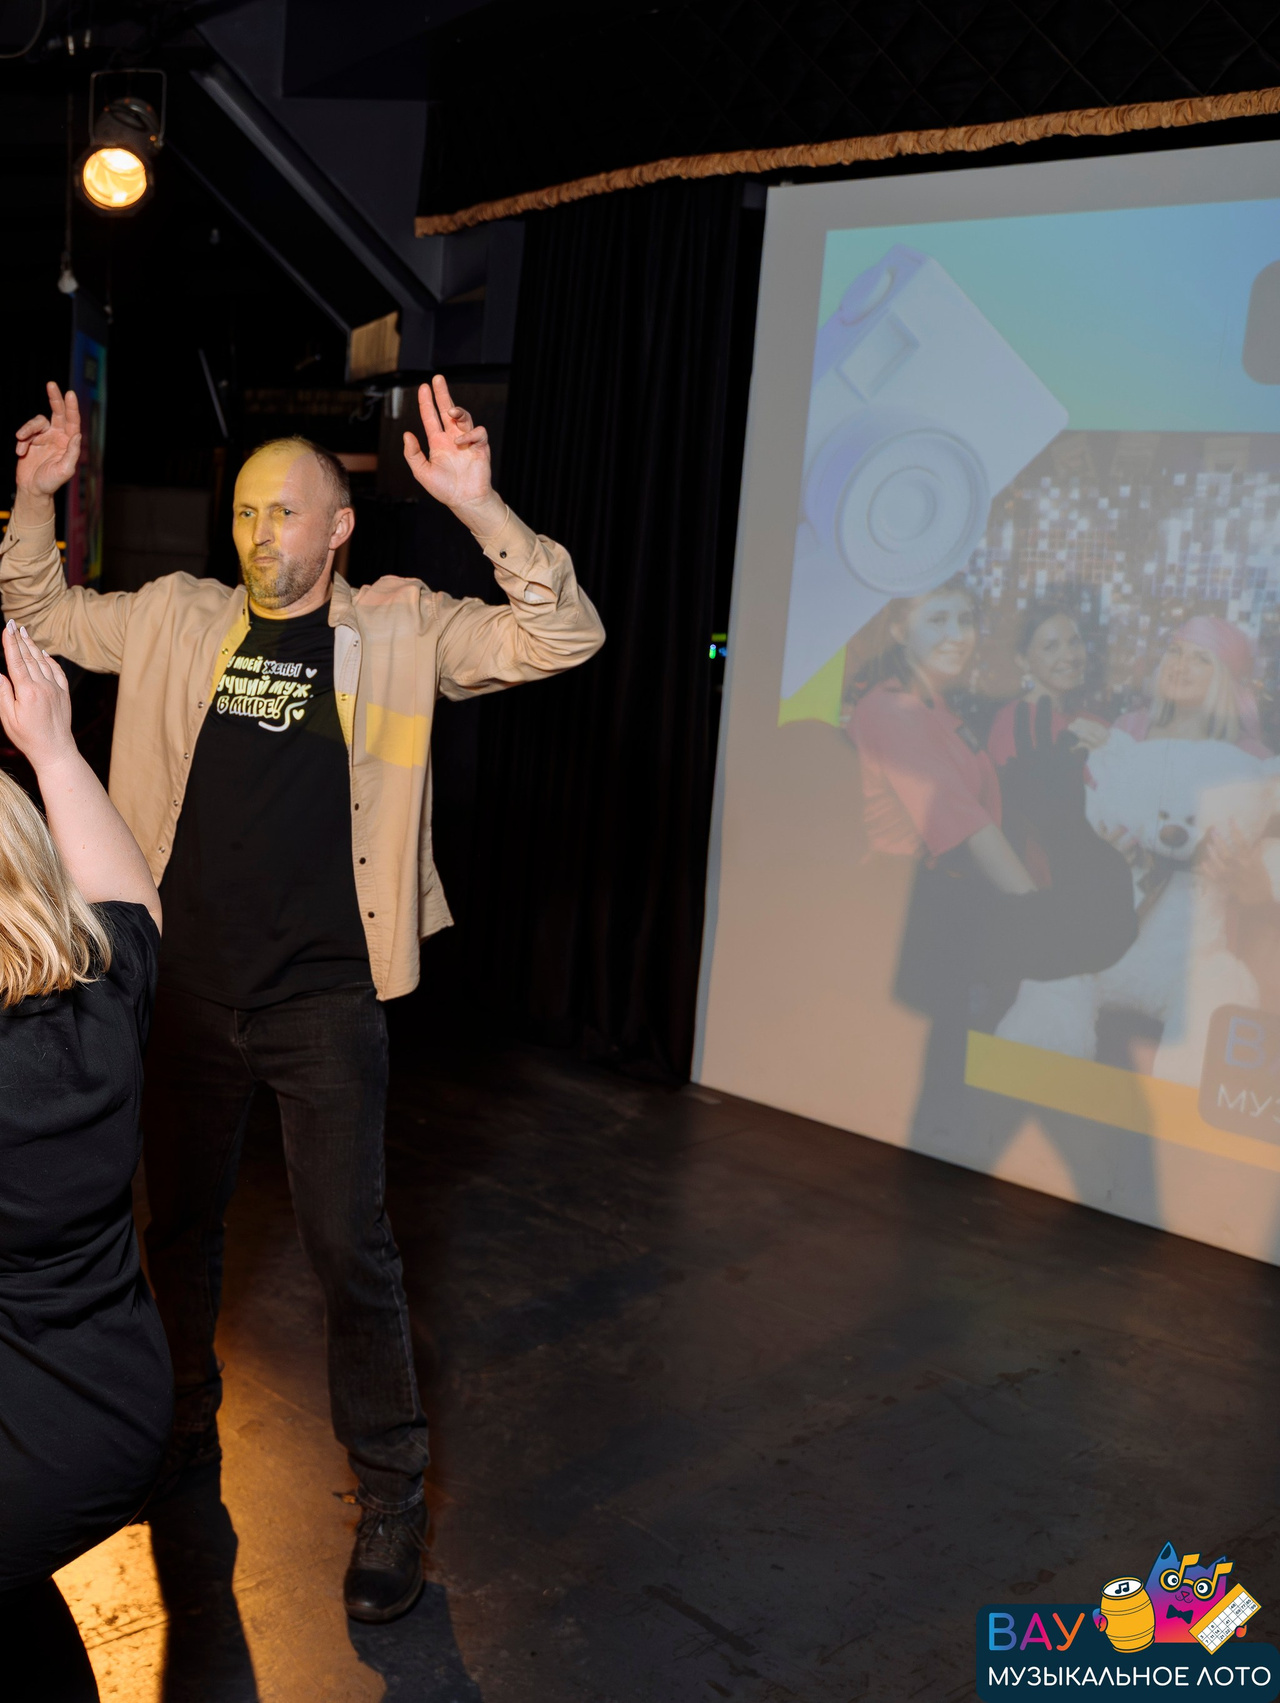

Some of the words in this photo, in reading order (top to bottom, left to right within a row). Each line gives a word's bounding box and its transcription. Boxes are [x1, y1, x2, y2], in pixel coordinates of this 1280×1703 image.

[233, 656, 264, 673] МОЕЙ
[216, 674, 271, 696] УЧШИЙ
[268, 680, 312, 698] МУЖ
[229, 695, 289, 719] МИРЕ!
